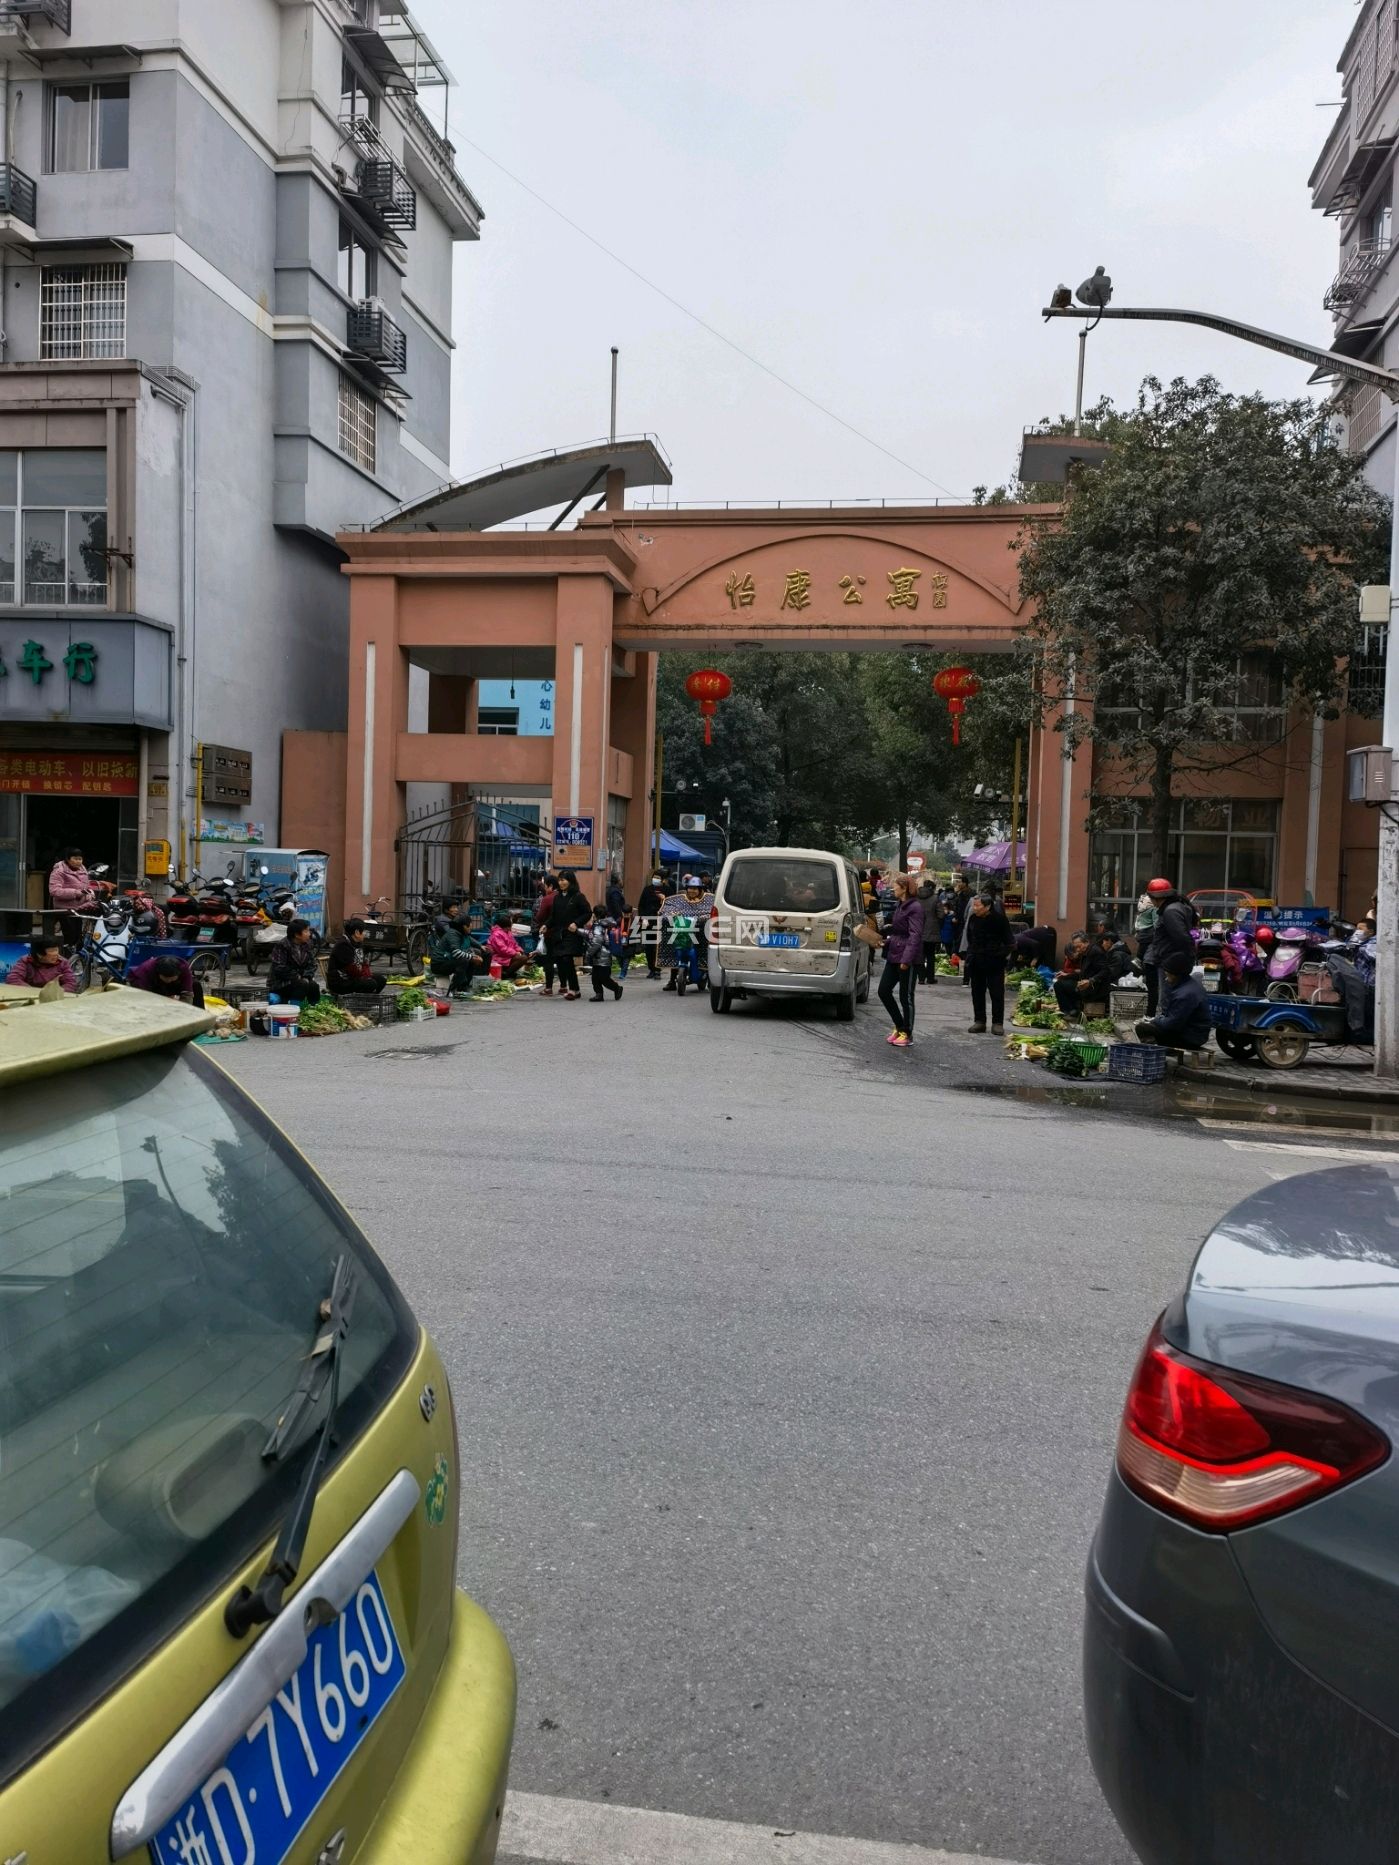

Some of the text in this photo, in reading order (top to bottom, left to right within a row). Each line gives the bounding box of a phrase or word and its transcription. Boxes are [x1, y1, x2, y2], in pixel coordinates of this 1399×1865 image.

[725, 567, 922, 611] 怡康公寓
[0, 639, 98, 685] 车行
[1263, 910, 1305, 920] 温提示
